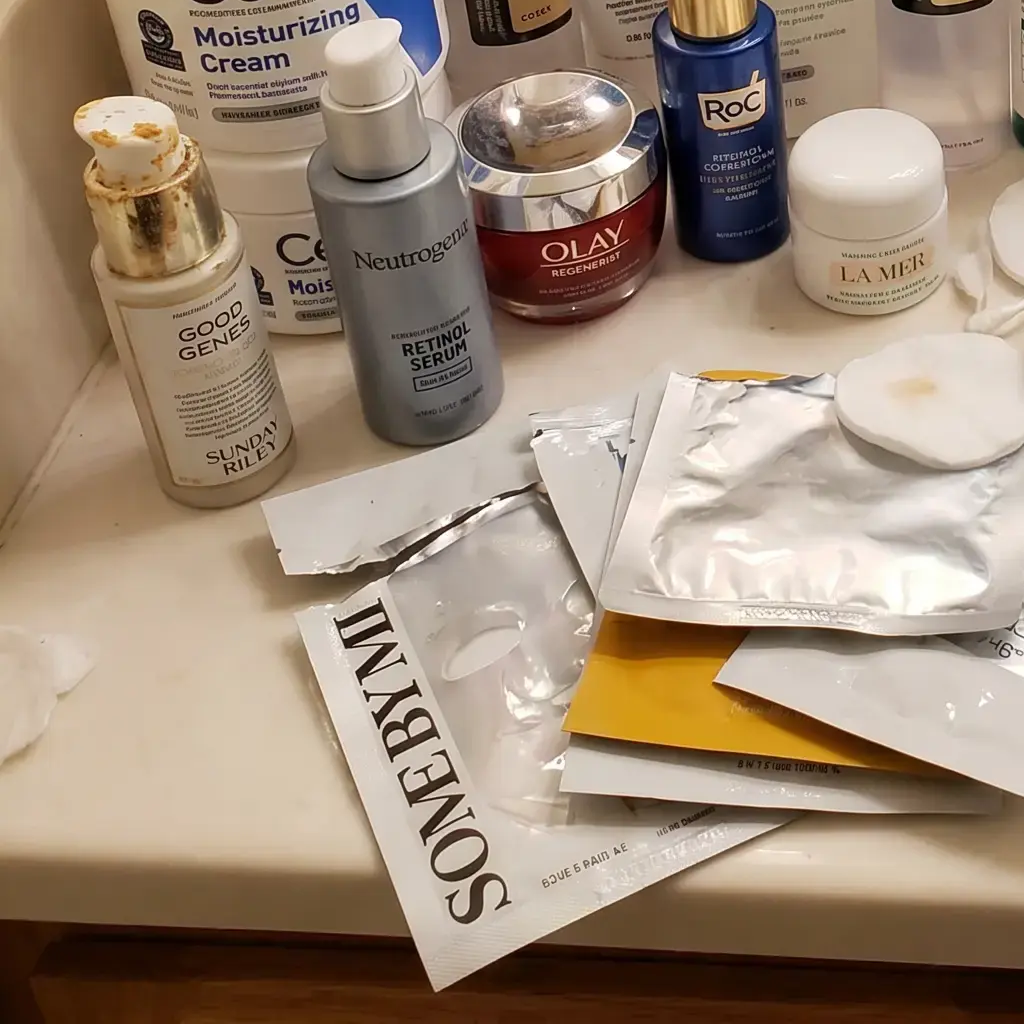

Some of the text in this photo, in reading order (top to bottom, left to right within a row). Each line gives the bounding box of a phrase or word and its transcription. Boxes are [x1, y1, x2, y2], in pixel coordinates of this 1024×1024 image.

[194, 2, 361, 47] Moisturizing
[200, 51, 291, 73] Cream
[704, 91, 762, 123] RoC
[541, 219, 624, 262] OLAY
[551, 251, 621, 277] REGENERIST
[840, 251, 925, 283] LA MER
[178, 300, 243, 343] GOOD
[178, 314, 251, 361] GENES
[401, 322, 472, 357] RETINOL
[409, 339, 468, 372] SERUM
[206, 414, 278, 465] SUNDAY
[223, 434, 276, 476] RILEY
